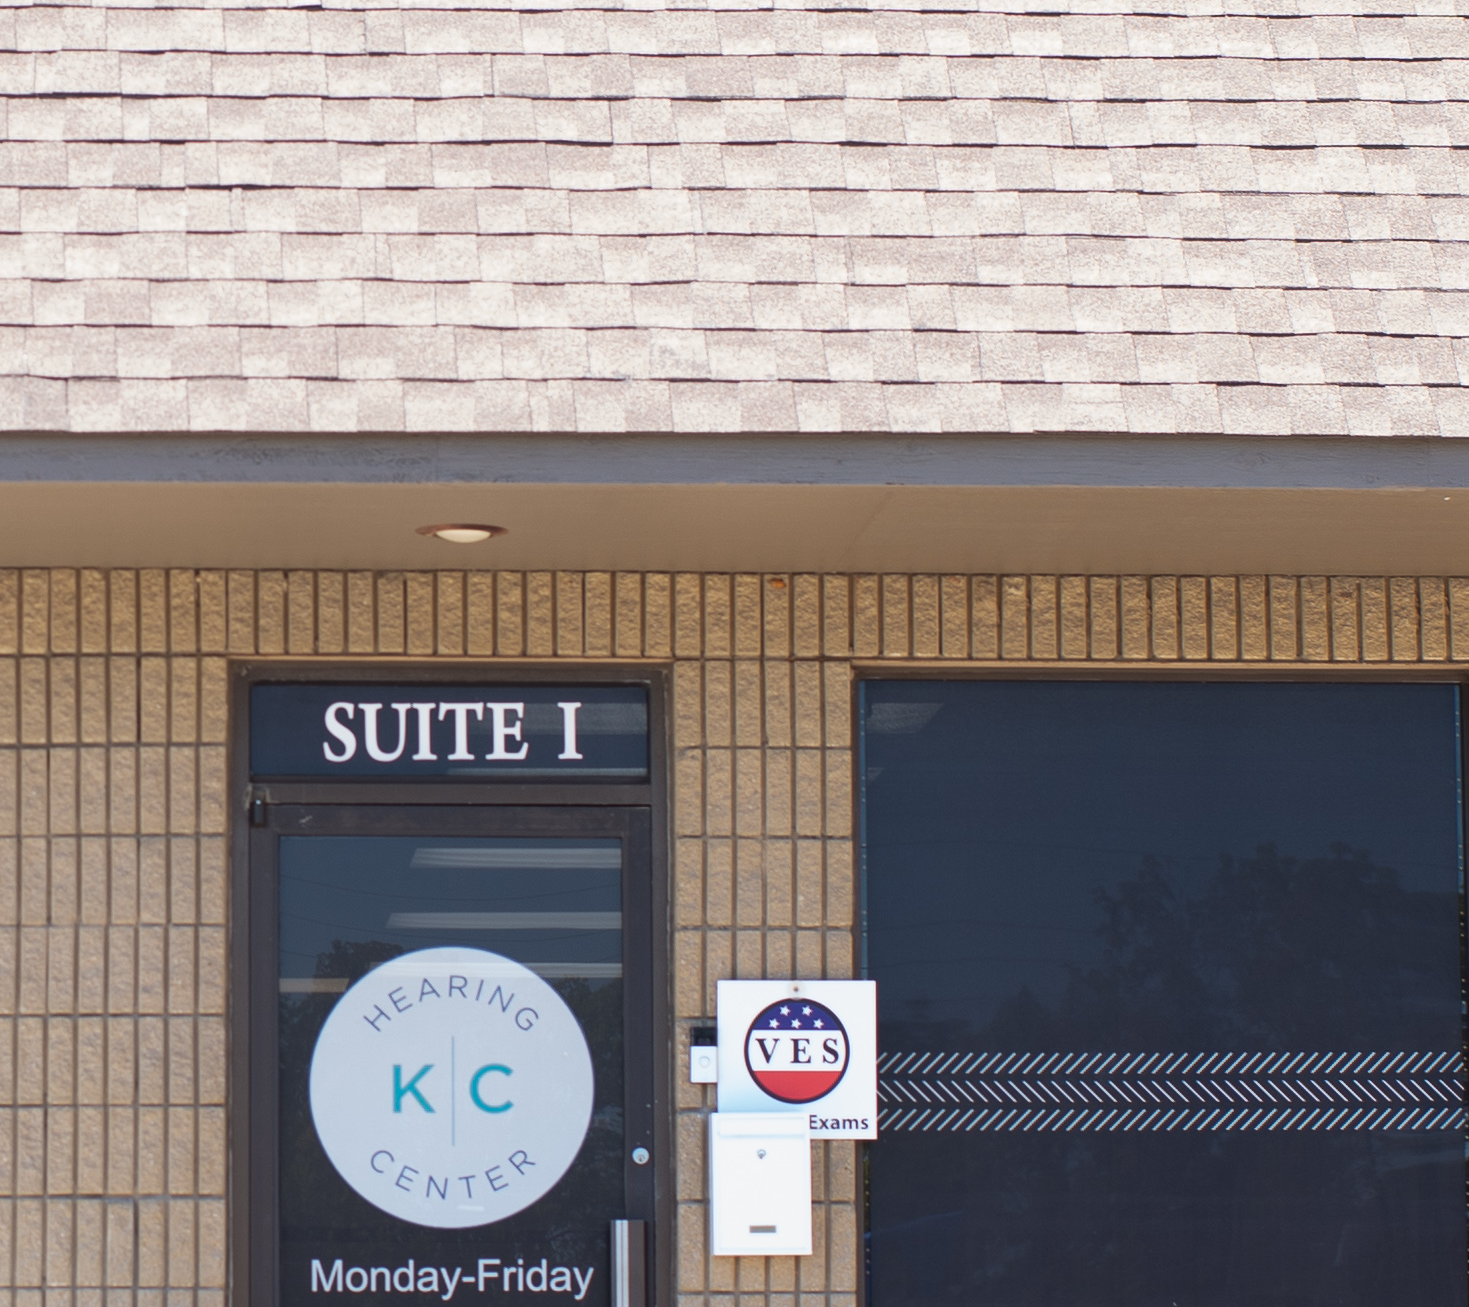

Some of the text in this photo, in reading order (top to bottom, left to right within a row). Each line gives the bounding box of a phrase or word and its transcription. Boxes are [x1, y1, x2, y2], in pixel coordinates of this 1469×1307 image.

[322, 701, 583, 763] SUITE I
[362, 974, 540, 1032] HEARING
[755, 1037, 840, 1064] VES
[809, 1114, 870, 1130] Exams
[370, 1149, 537, 1200] CENTER
[310, 1258, 594, 1301] Monday-Friday
